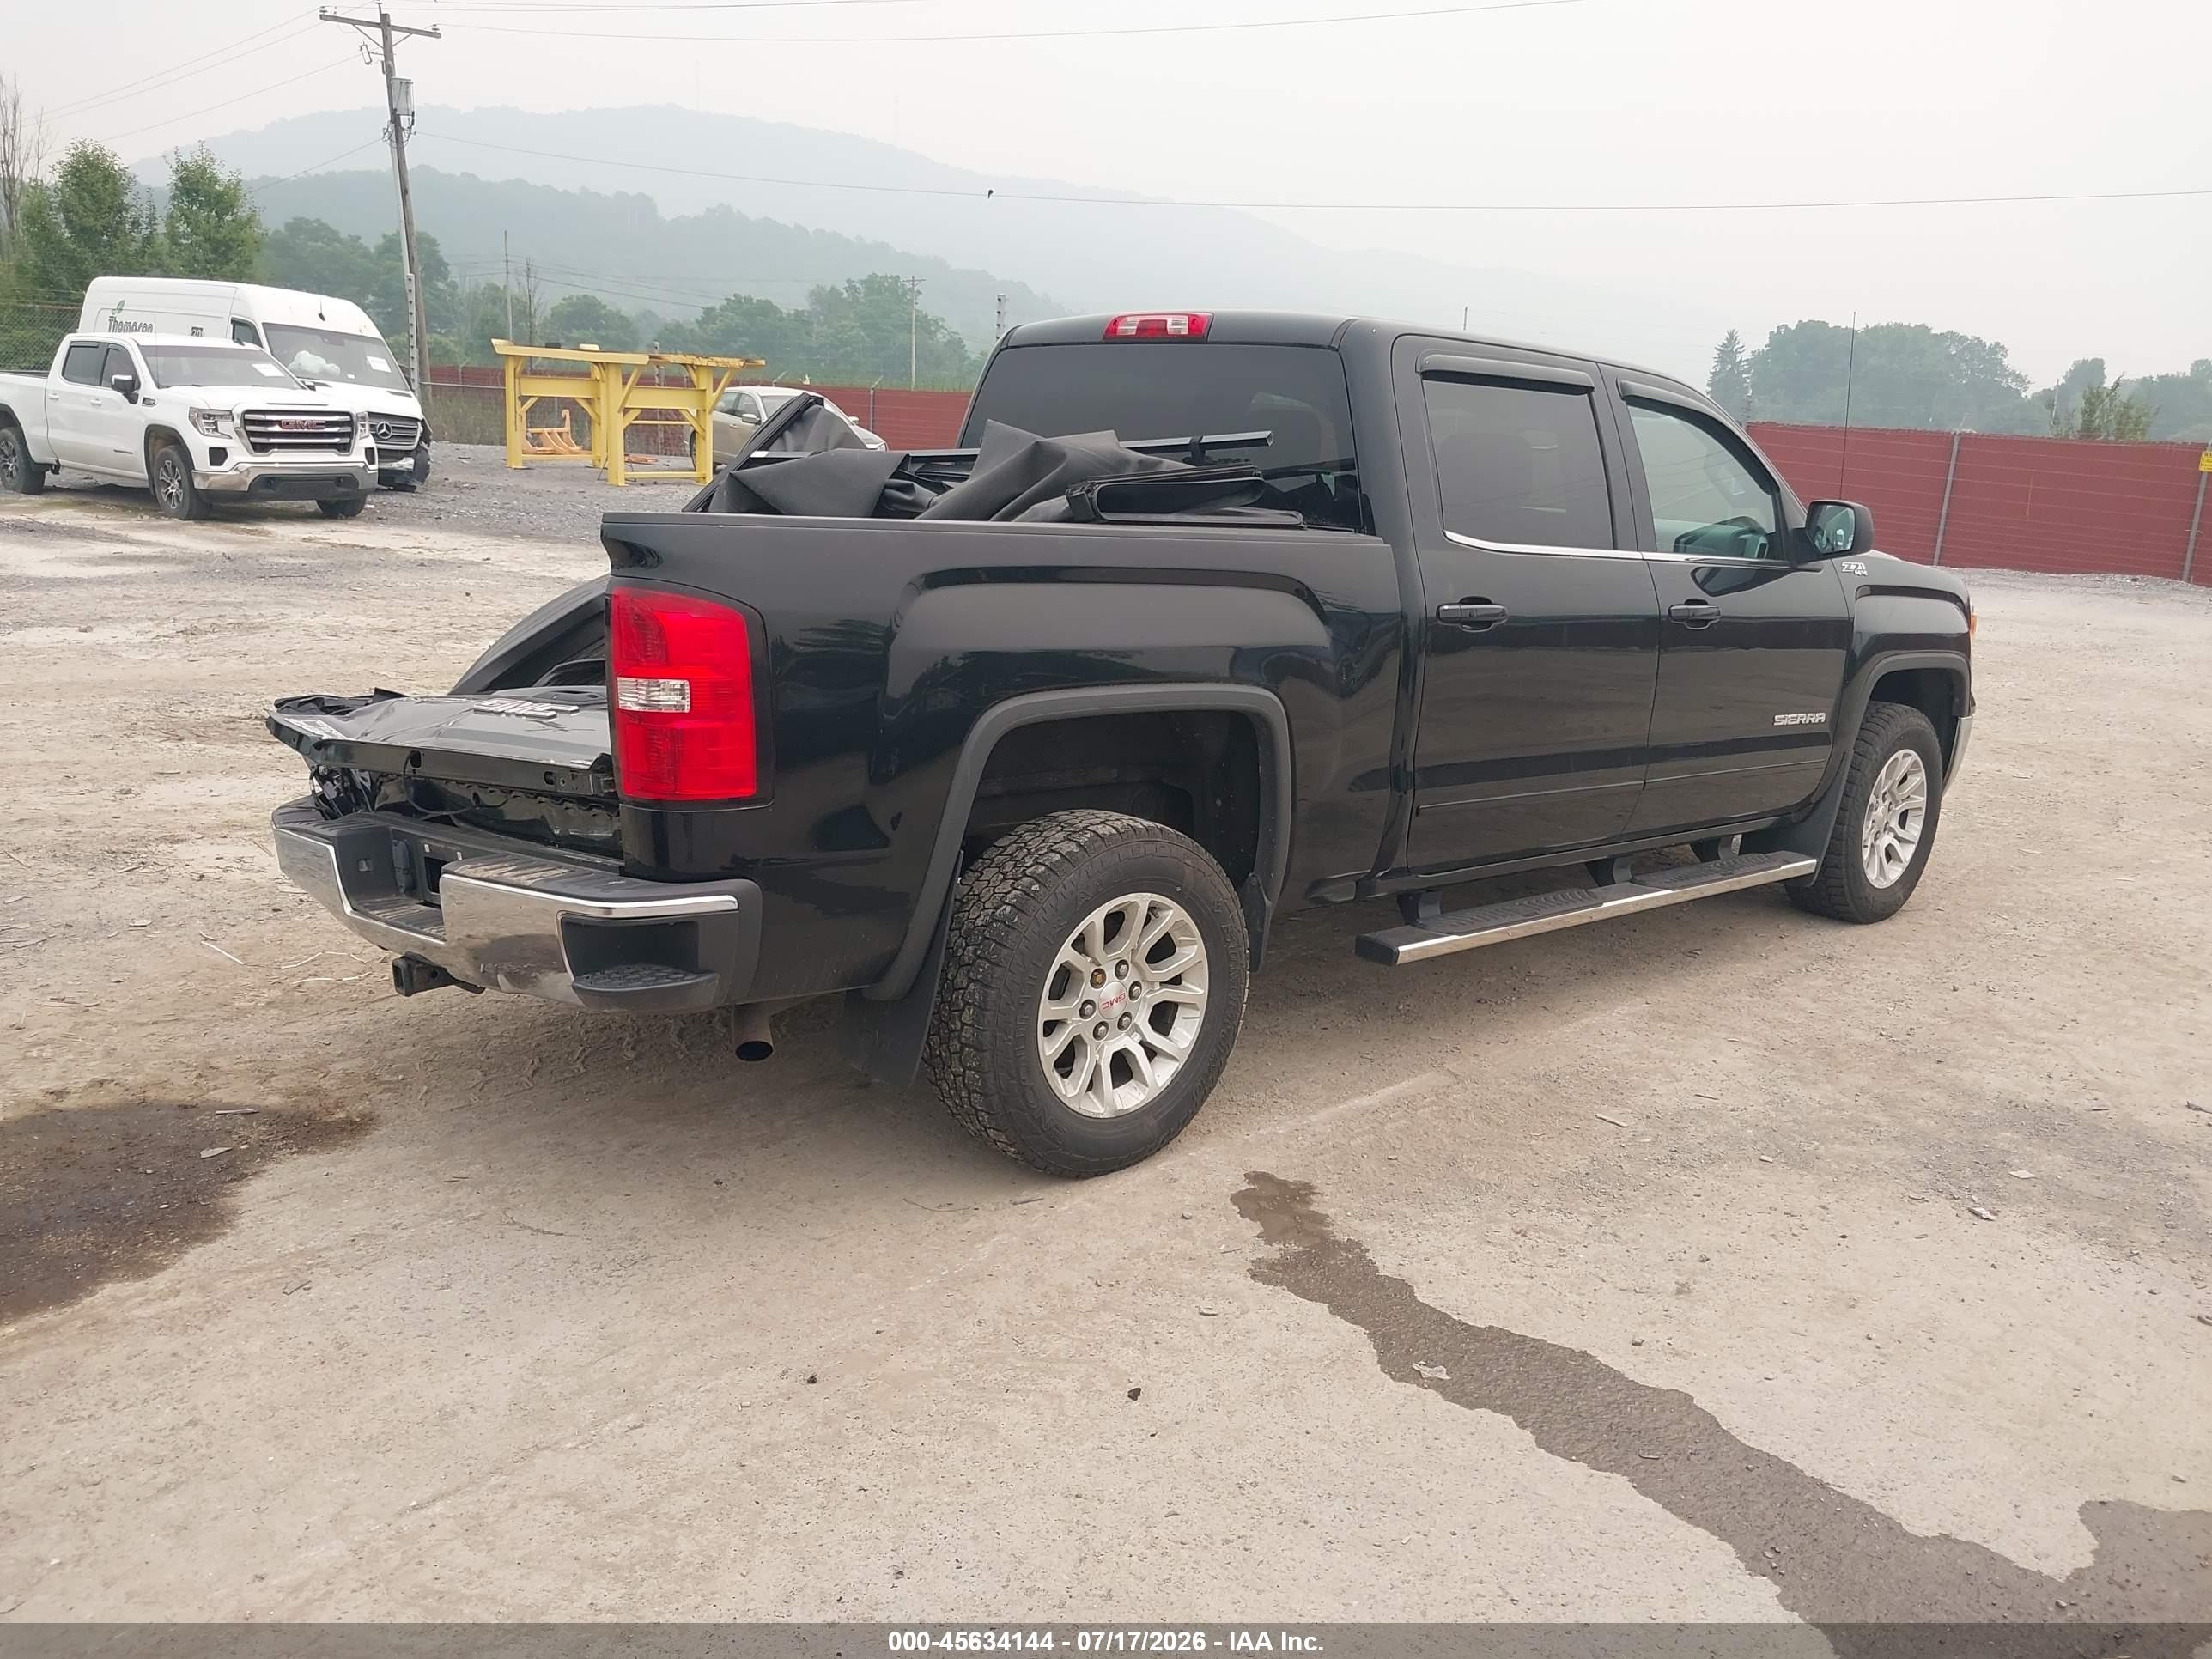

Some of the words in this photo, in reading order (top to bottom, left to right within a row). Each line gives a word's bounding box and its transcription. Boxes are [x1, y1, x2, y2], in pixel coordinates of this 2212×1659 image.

[281, 419, 325, 430] GMC
[474, 697, 579, 720] GMC
[1773, 712, 1826, 726] SIERRA
[1102, 993, 1126, 1010] GMC
